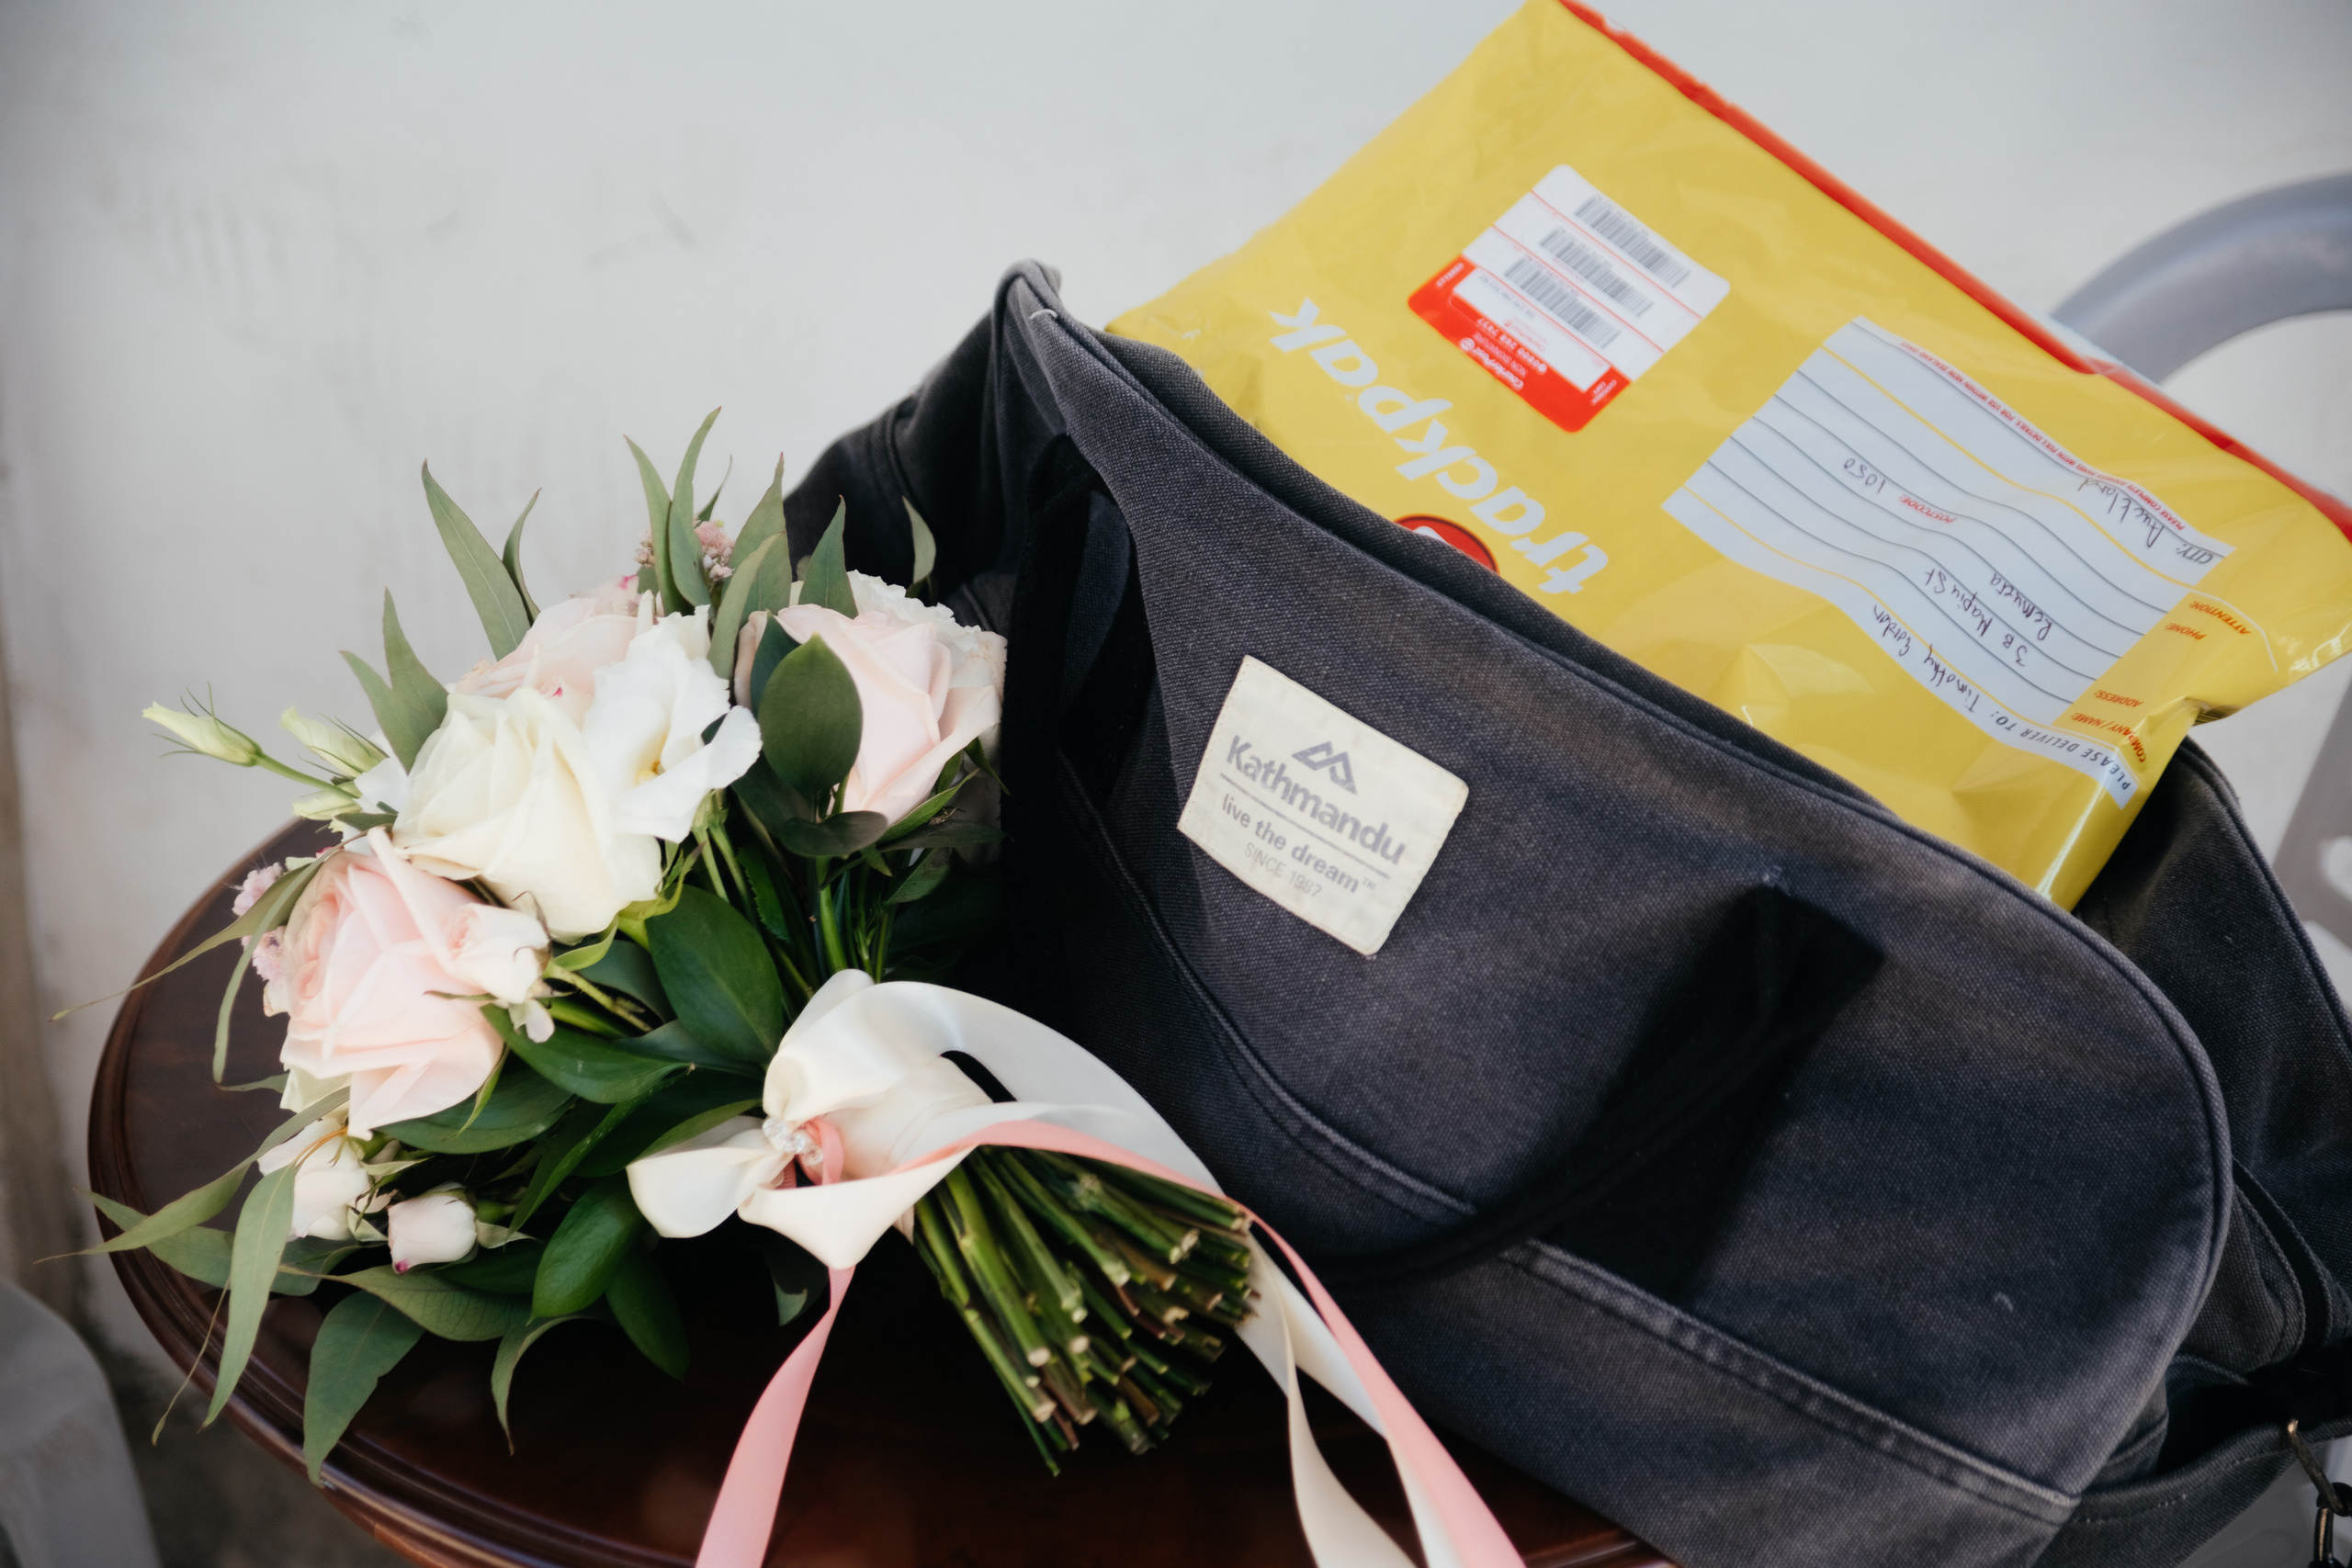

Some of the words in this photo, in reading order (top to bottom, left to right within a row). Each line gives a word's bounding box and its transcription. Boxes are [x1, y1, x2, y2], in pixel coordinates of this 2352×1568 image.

[1471, 347, 1523, 389] CourierPost
[1919, 353, 1949, 372] ZEALAND
[1948, 371, 1963, 383] NEW
[1963, 382, 1988, 401] WITHIN
[1987, 400, 2001, 411] USE
[2000, 410, 2014, 421] FOR
[1268, 297, 1608, 594] trackpak
[2042, 440, 2058, 453] FULL
[2057, 452, 2075, 466] WITH
[1899, 496, 1956, 524] POSTCODE:
[2128, 485, 2161, 511] COMPLETE
[2078, 479, 2163, 548] Auckland
[2160, 511, 2184, 530] PLEASE
[2176, 539, 2214, 564] CITY:
[1926, 568, 1947, 594] St
[2190, 601, 2250, 634] ATTENTION:
[2165, 623, 2206, 641] PHONE:
[1924, 645, 1979, 712] Timothy
[2094, 689, 2143, 708] ADDRESS:
[1991, 711, 2018, 731] TO:
[2020, 728, 2080, 753] DELIVER
[2081, 748, 2132, 791] PLEASE
[1226, 735, 1406, 864] Kathmandu
[1223, 793, 1250, 828] live
[1255, 820, 1286, 850] the
[1245, 842, 1286, 877] SINCE
[1290, 871, 1323, 897] 1987
